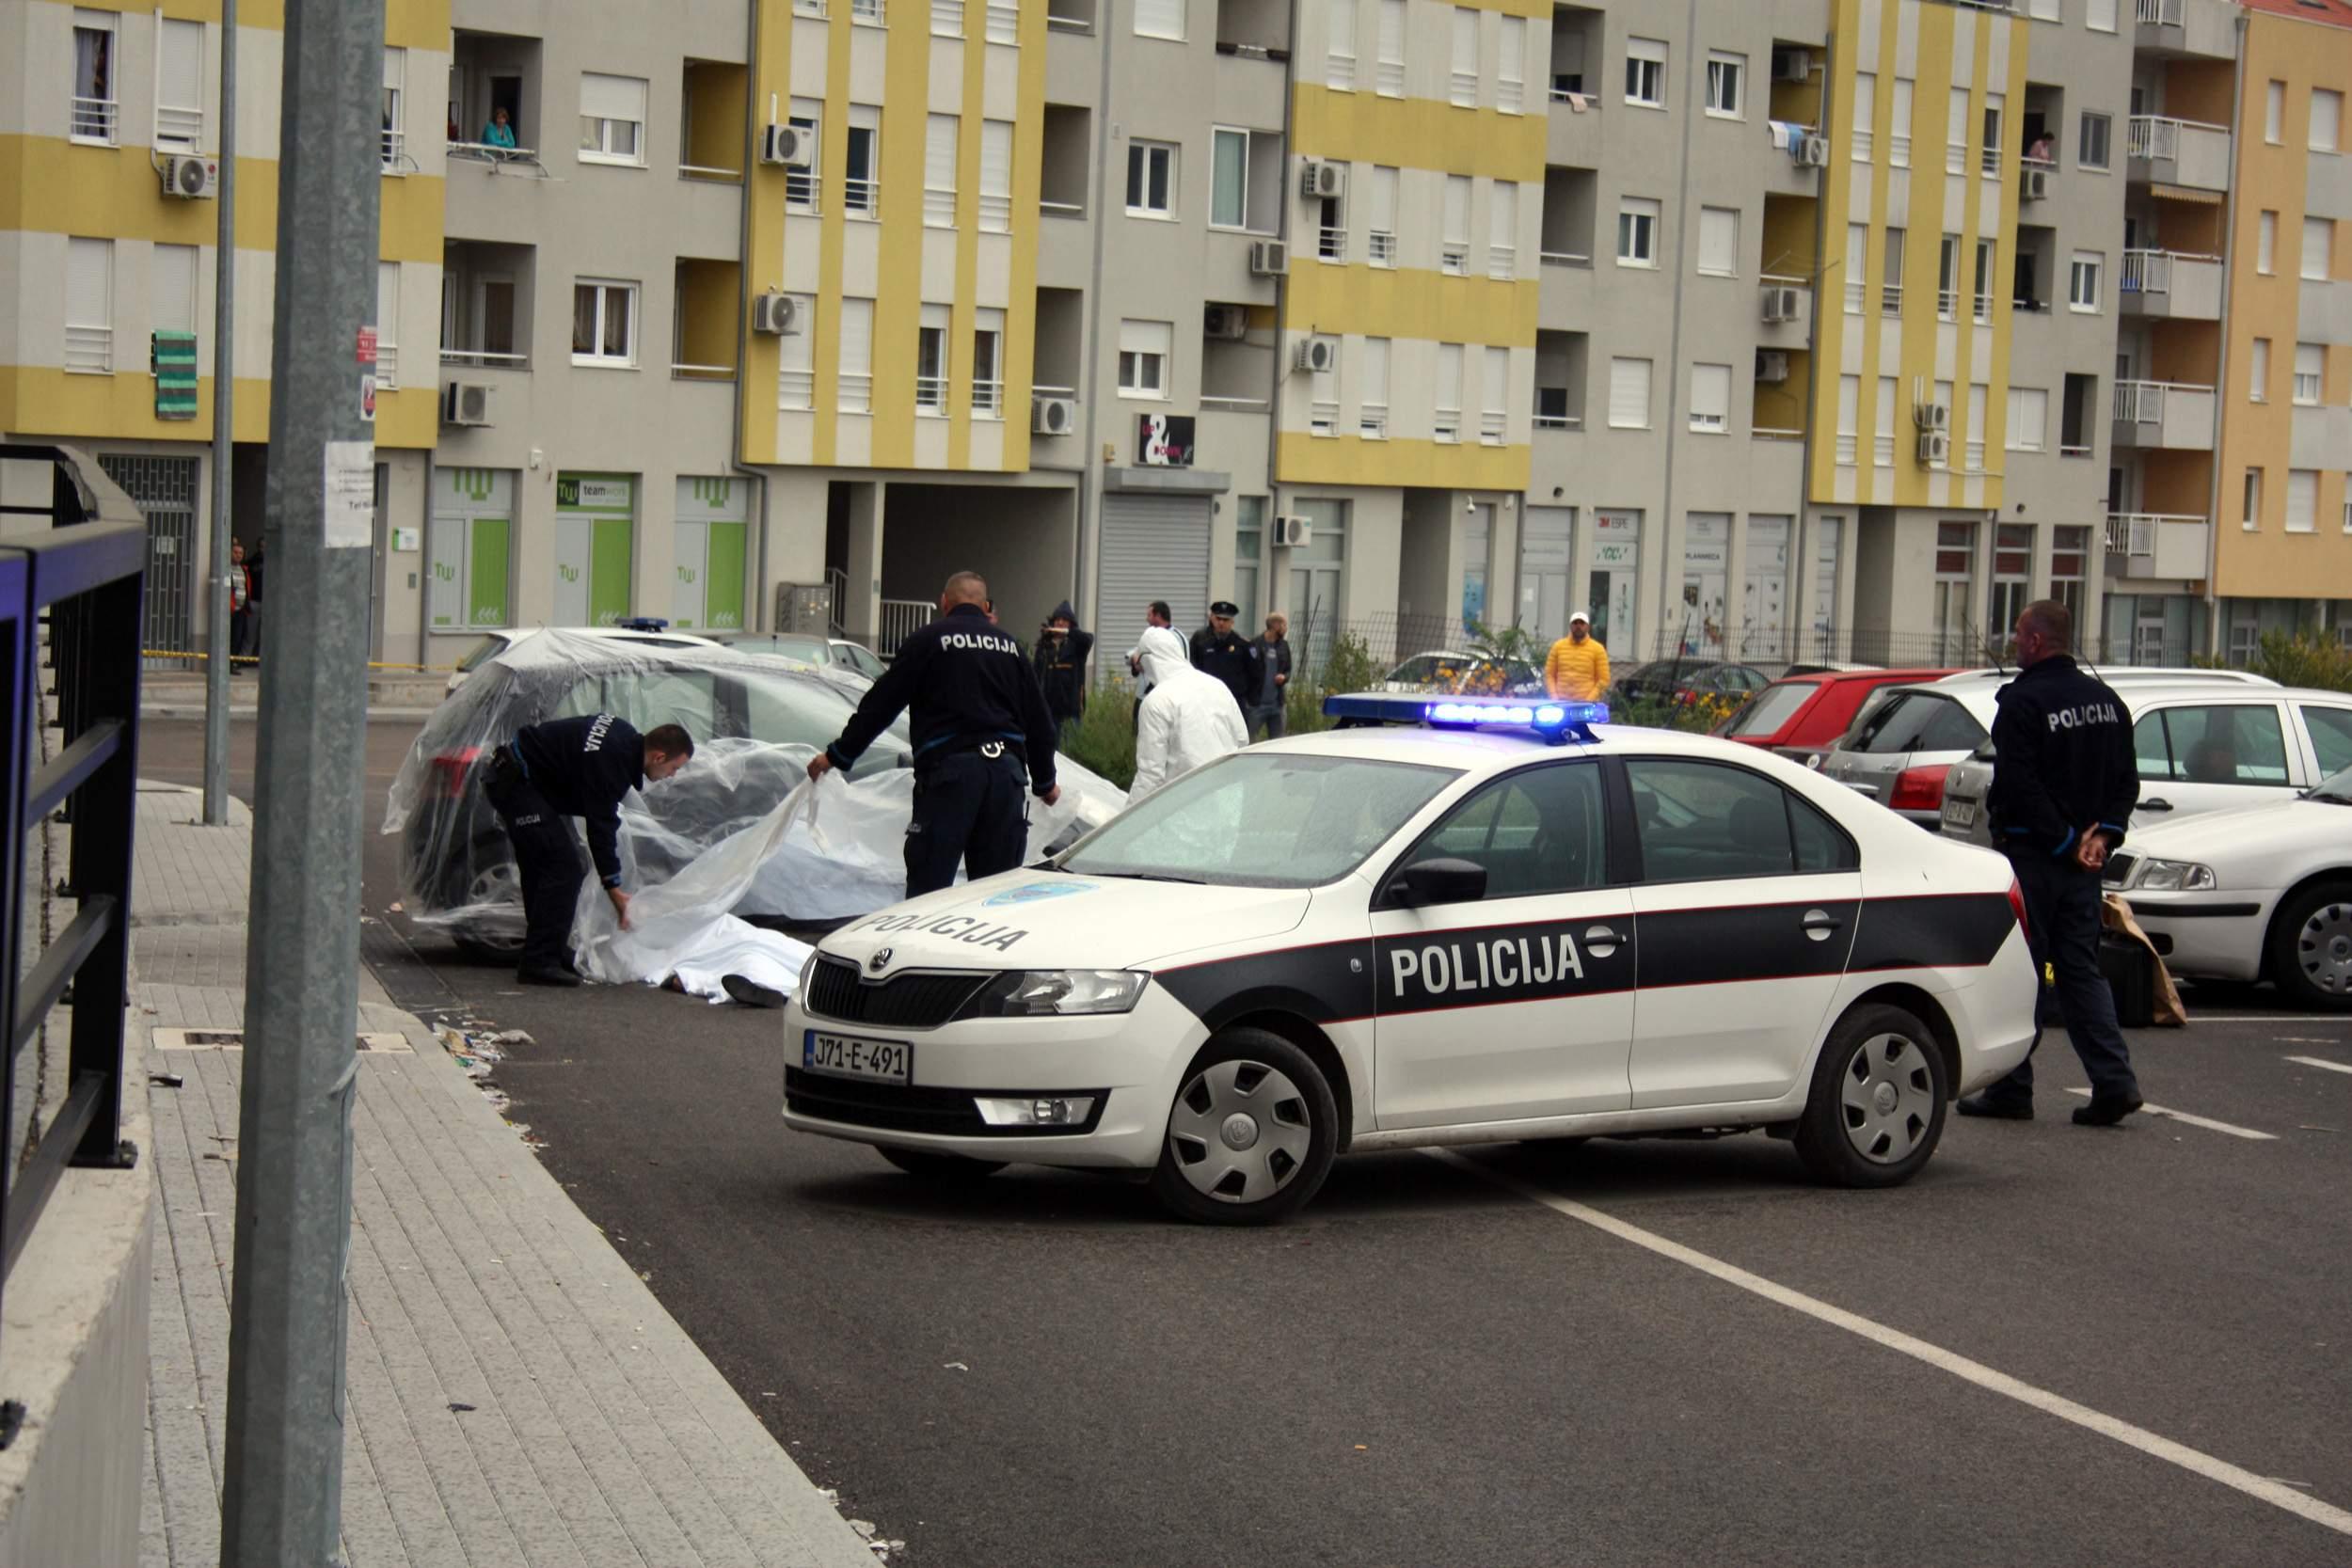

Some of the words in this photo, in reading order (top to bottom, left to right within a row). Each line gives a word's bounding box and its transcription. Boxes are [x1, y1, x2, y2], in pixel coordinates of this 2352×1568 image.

[1146, 414, 1170, 466] &
[941, 633, 1019, 657] POLICIJA
[2047, 703, 2120, 732] POLICIJA
[850, 914, 1030, 953] POLICIJA
[1391, 933, 1584, 997] POLICIJA
[815, 1037, 905, 1075] J71-E-491
